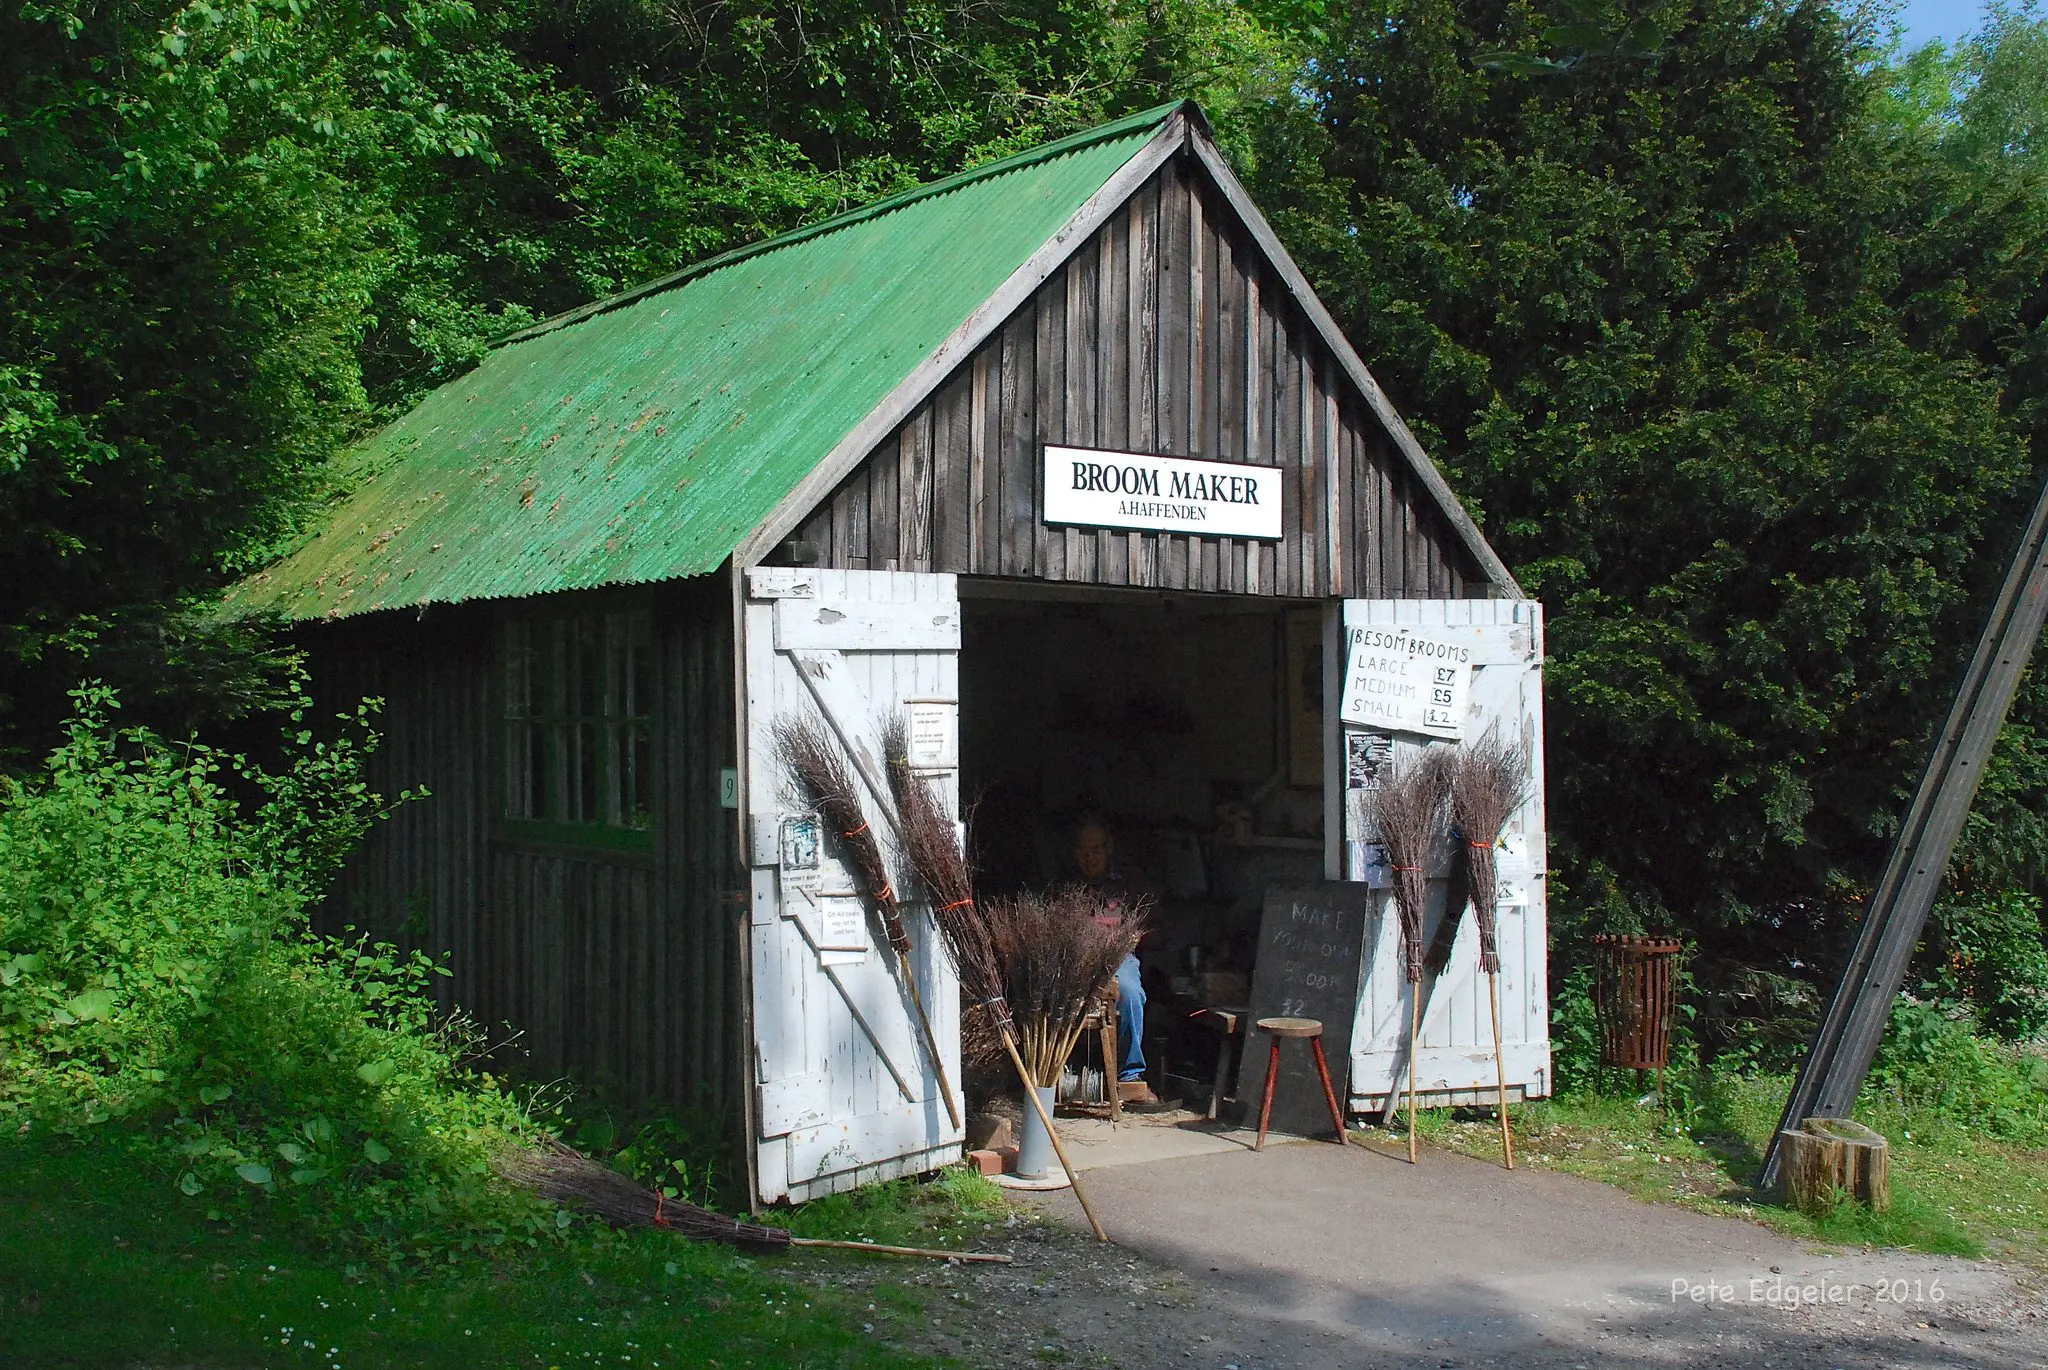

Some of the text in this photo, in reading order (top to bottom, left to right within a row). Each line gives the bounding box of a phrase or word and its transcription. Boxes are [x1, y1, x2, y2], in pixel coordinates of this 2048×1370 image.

[1072, 462, 1259, 505] BROOM MAKER
[1118, 500, 1207, 521] A.HAFFENDEN
[1355, 629, 1469, 663] BESOM BROOMS
[1358, 655, 1408, 676] LARGE
[1437, 667, 1455, 682] £7
[1355, 676, 1416, 699] MEDIUM
[1434, 688, 1452, 703] £5
[1353, 698, 1403, 719] SMALL
[726, 778, 734, 799] 9
